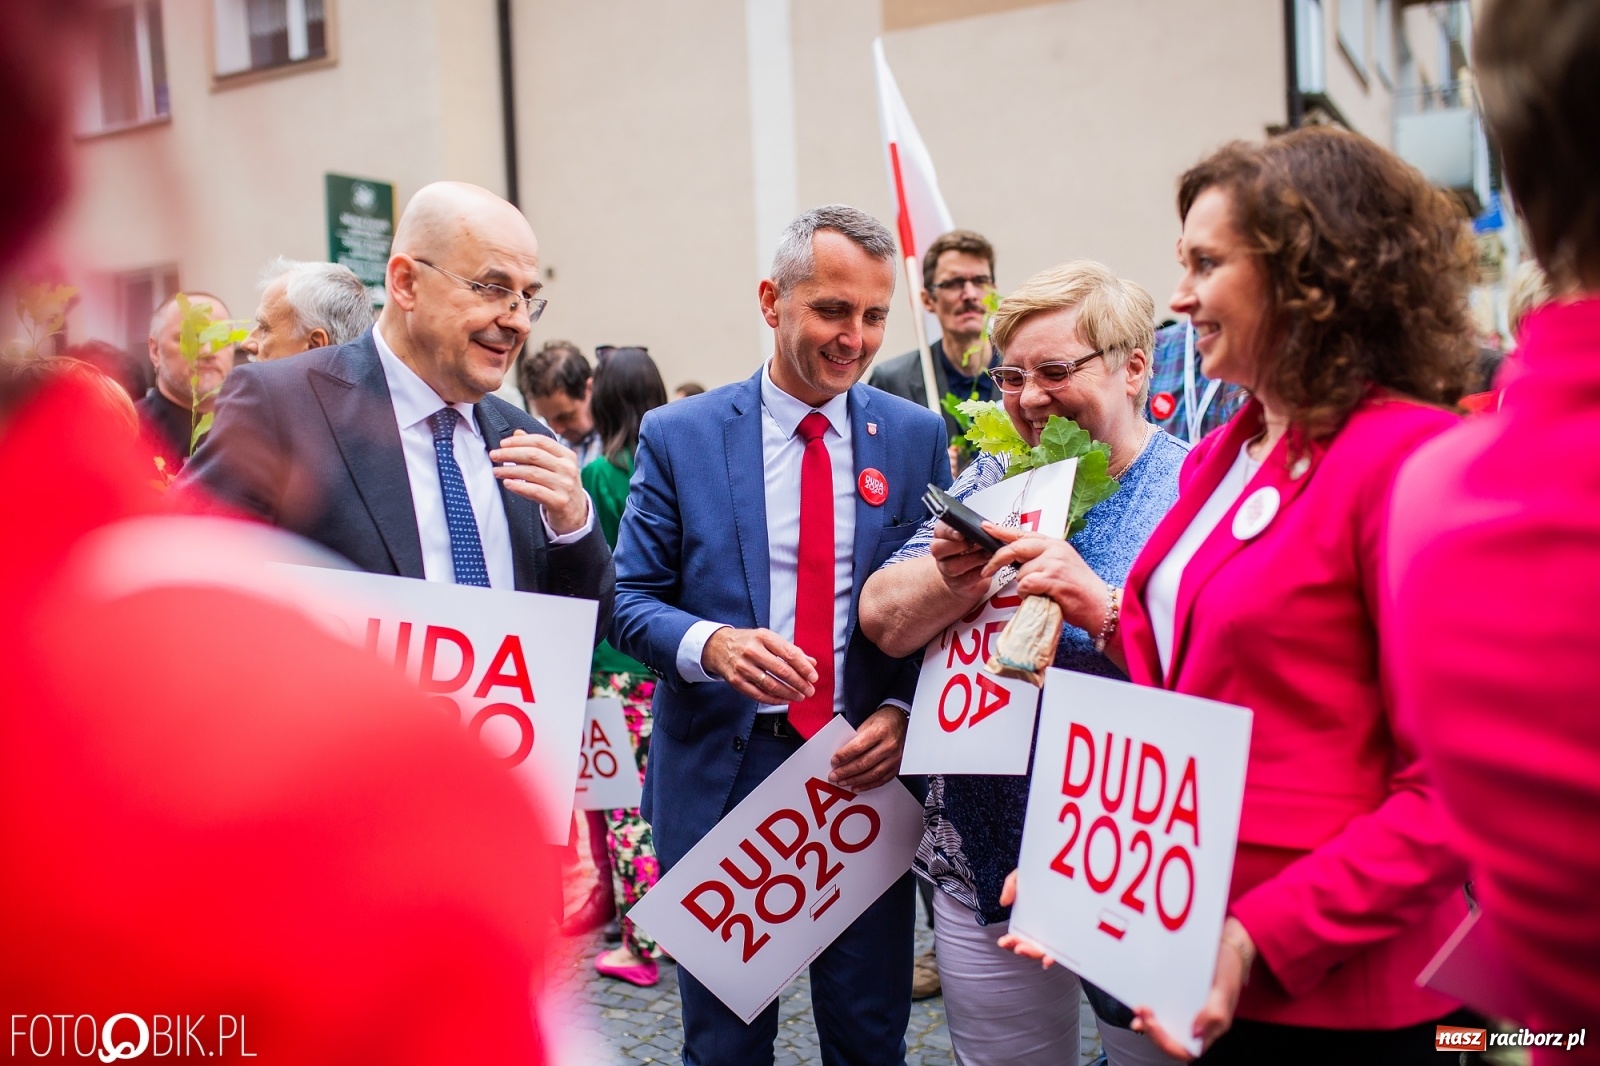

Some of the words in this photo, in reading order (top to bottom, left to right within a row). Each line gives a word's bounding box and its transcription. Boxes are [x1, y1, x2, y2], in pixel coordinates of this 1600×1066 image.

[864, 481, 884, 495] 2020
[865, 475, 884, 488] DUDA
[1061, 722, 1200, 847] DUDA
[680, 776, 858, 933] DUDA
[721, 804, 881, 964] 2020
[1049, 801, 1195, 932] 2020
